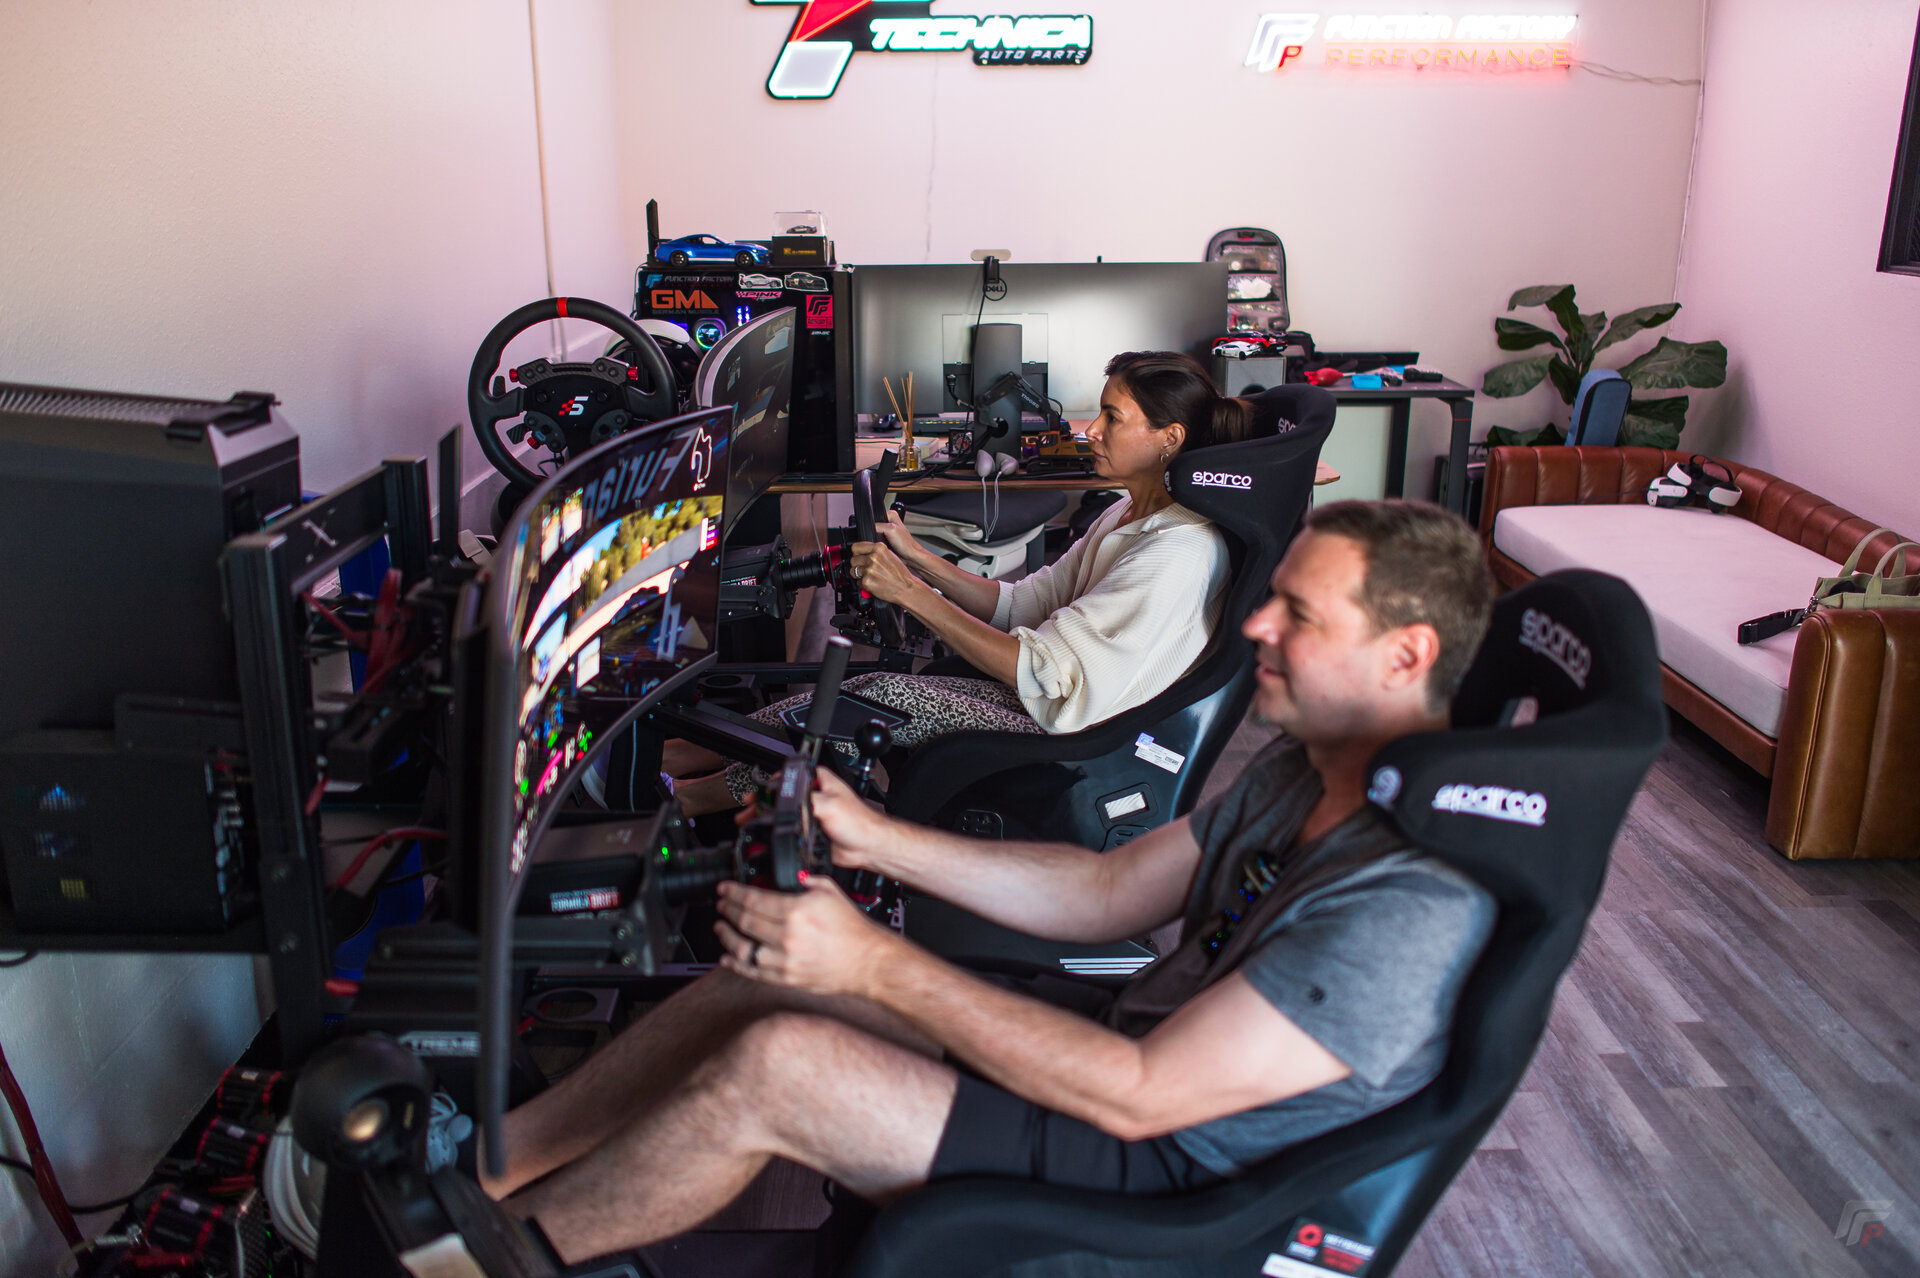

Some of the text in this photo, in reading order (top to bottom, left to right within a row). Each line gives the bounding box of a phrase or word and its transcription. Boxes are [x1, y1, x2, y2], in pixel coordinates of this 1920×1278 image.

[980, 50, 1087, 59] AUTO PARTS
[1326, 48, 1569, 65] PERFORMANCE
[1191, 471, 1253, 489] sparco
[1431, 784, 1548, 827] sparco
